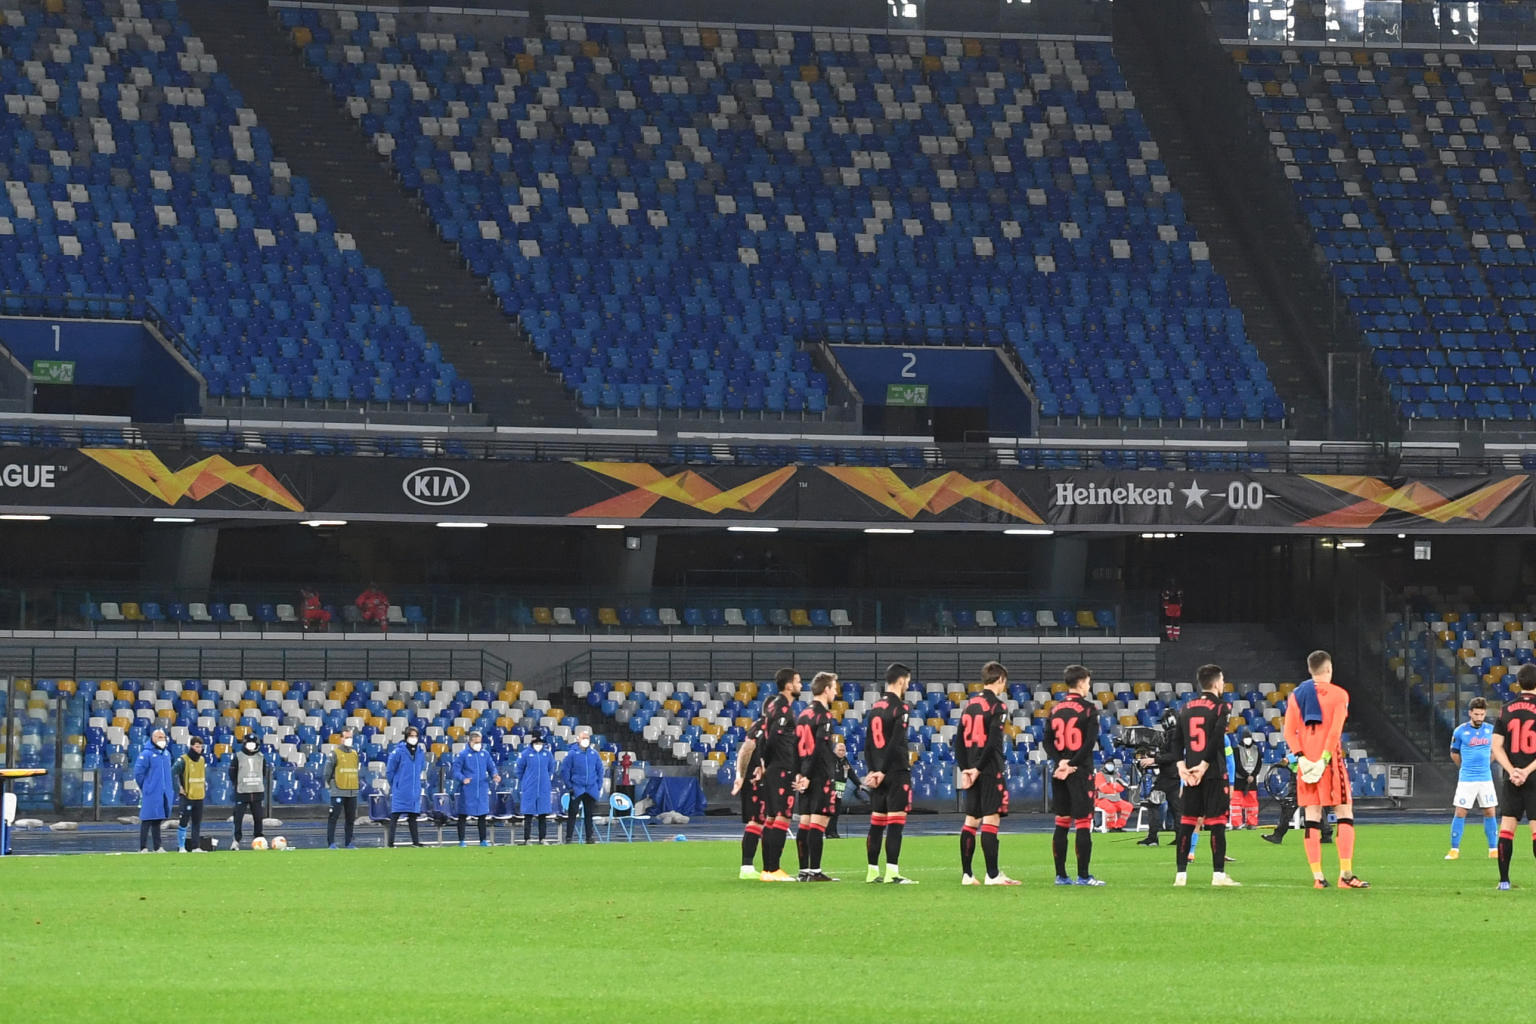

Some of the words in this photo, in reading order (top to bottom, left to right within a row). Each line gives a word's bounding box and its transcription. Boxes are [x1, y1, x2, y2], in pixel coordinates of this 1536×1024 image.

[51, 325, 60, 352] 1
[901, 352, 917, 378] 2
[0, 463, 56, 488] GUE
[414, 475, 459, 497] KIA
[1055, 482, 1174, 506] Heineken
[871, 716, 886, 750] 8
[961, 713, 988, 748] 24
[1051, 717, 1083, 752] 36
[1189, 716, 1207, 753] 5
